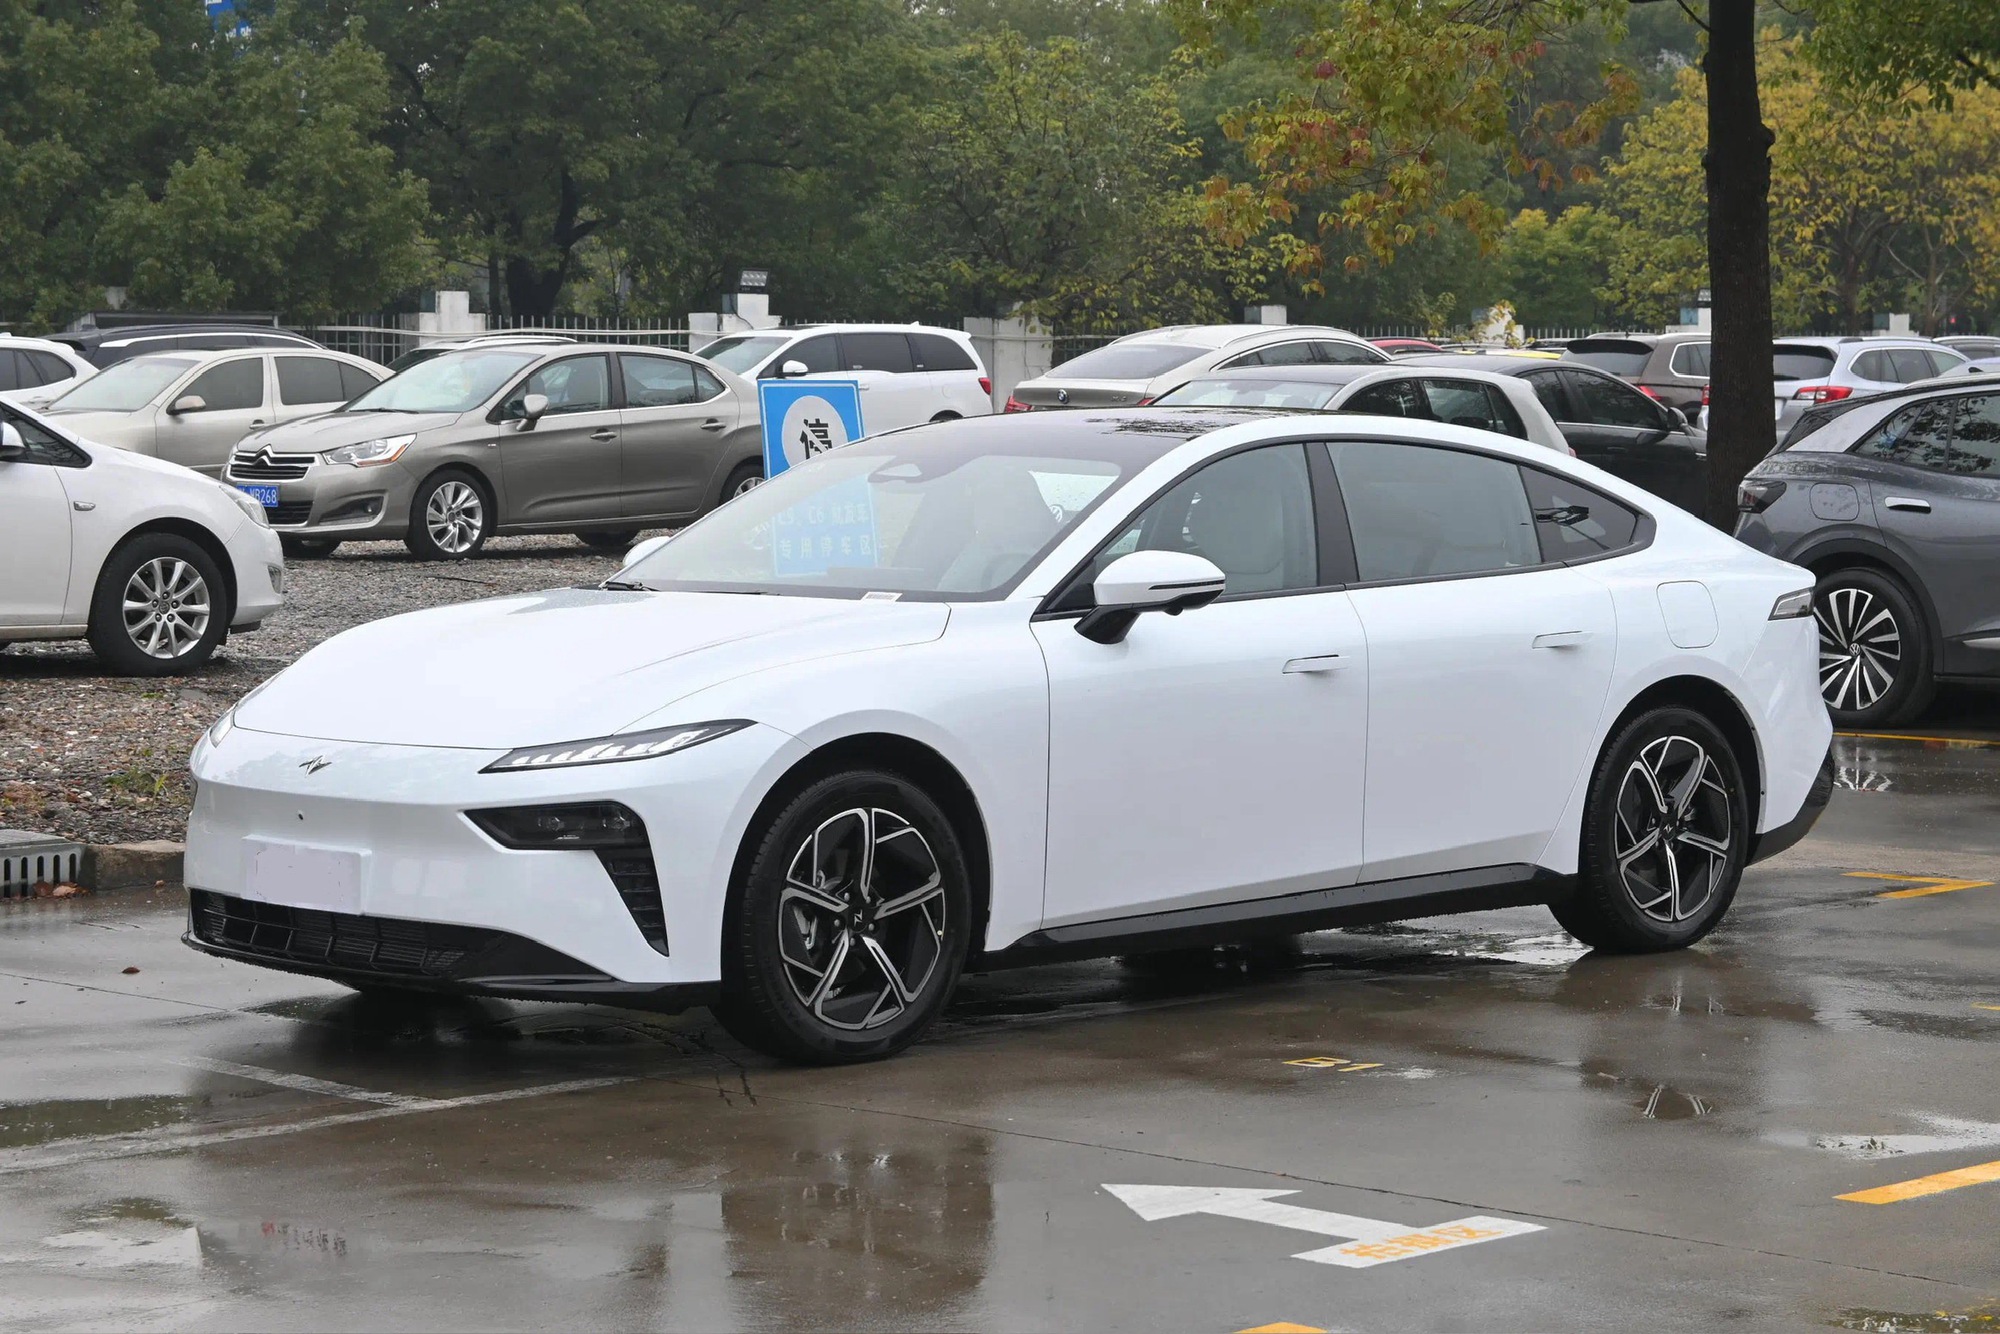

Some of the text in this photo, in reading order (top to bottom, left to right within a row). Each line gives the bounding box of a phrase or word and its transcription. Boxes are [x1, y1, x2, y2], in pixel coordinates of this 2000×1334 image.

[779, 535, 871, 559] 专用停车区
